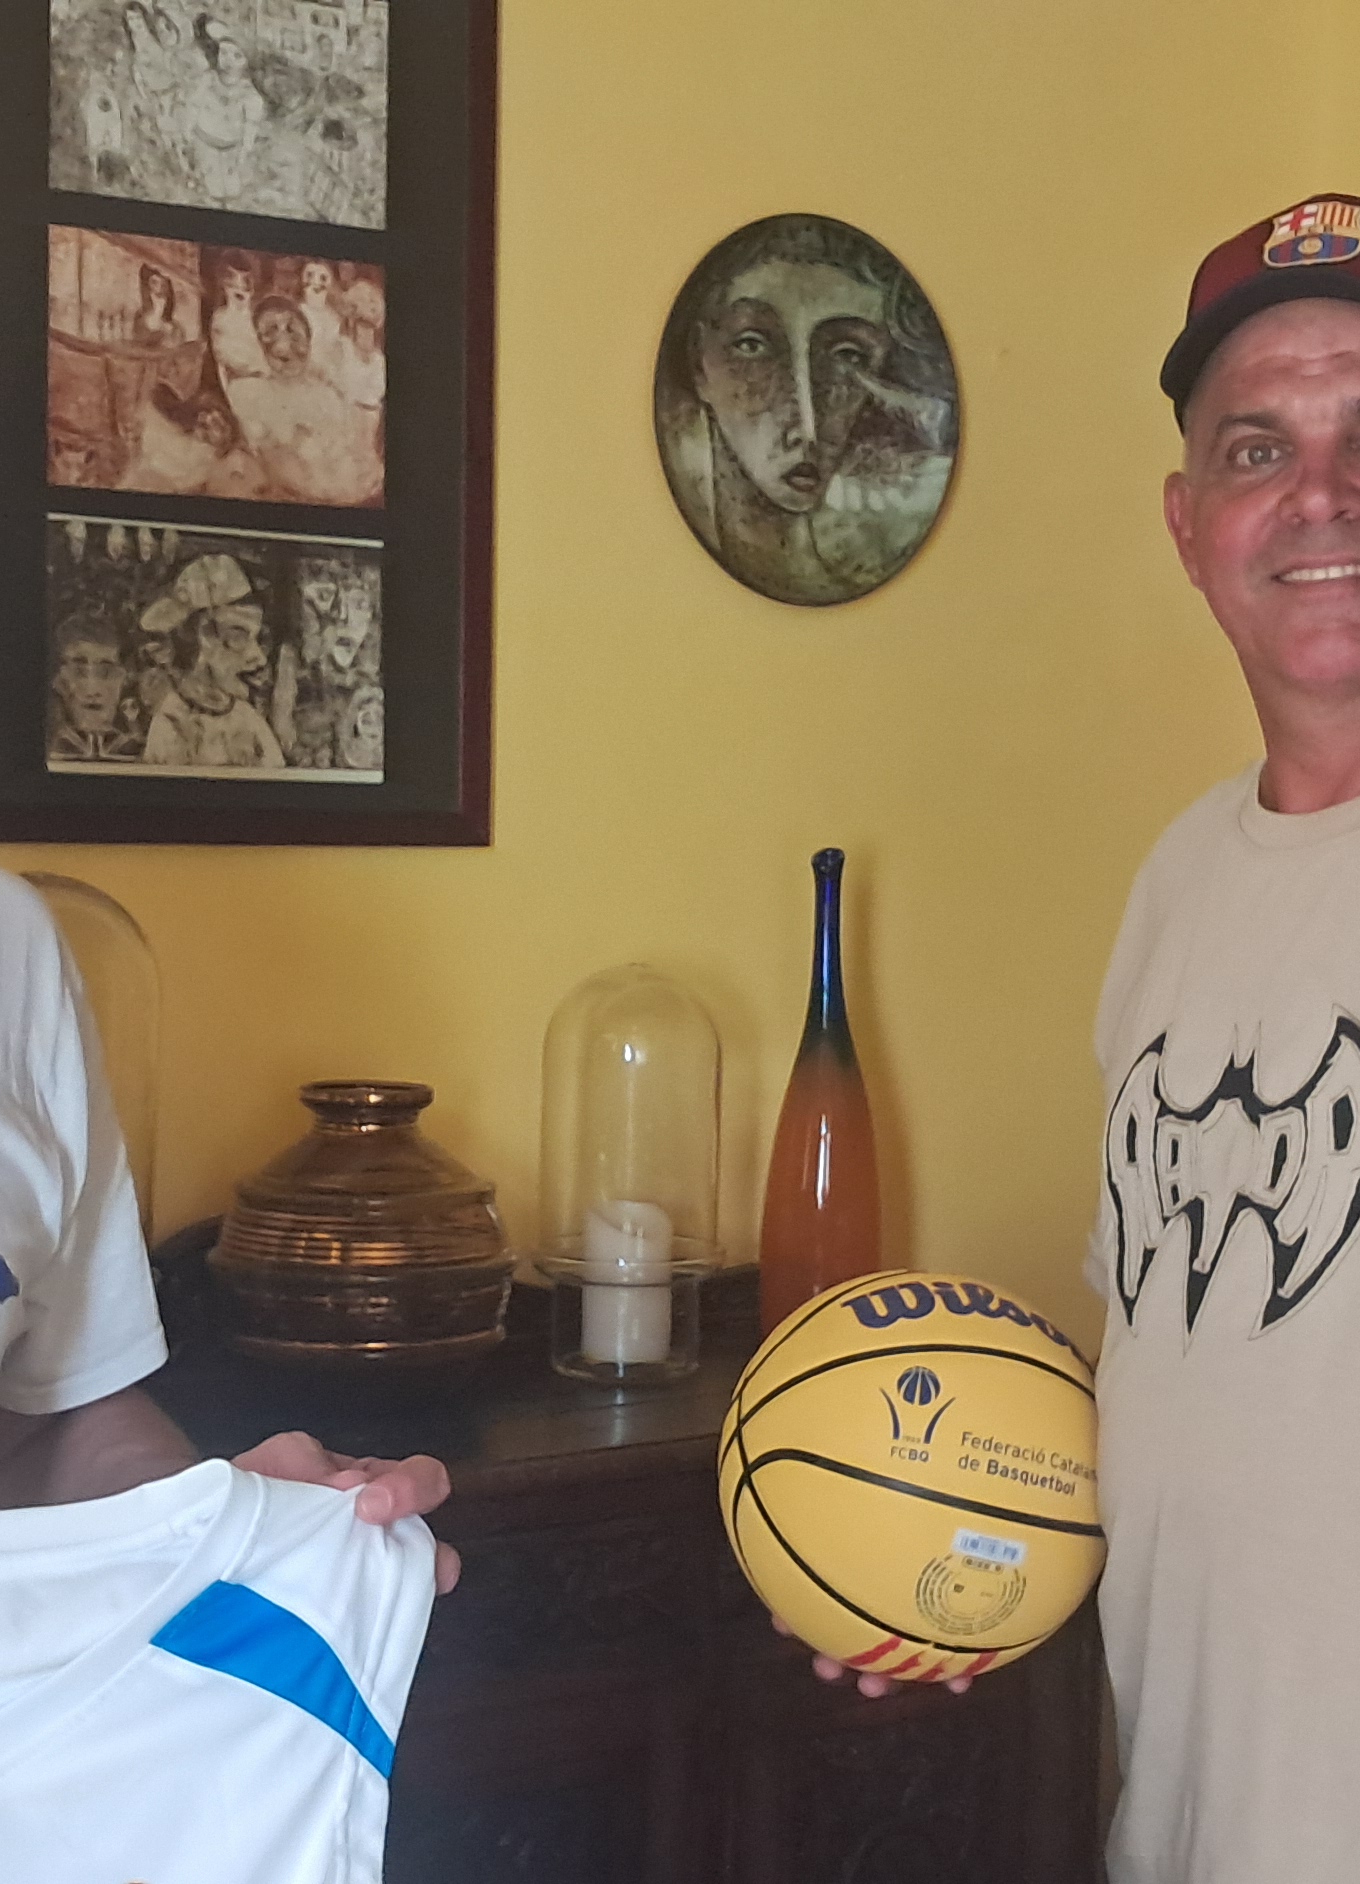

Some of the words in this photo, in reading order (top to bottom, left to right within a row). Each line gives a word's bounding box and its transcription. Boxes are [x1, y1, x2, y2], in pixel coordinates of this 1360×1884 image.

[841, 1281, 1095, 1374] Wilso
[890, 1445, 930, 1463] FCBQ
[960, 1431, 1047, 1466] Federació
[958, 1454, 981, 1473] de
[986, 1458, 1078, 1498] Basquetbol
